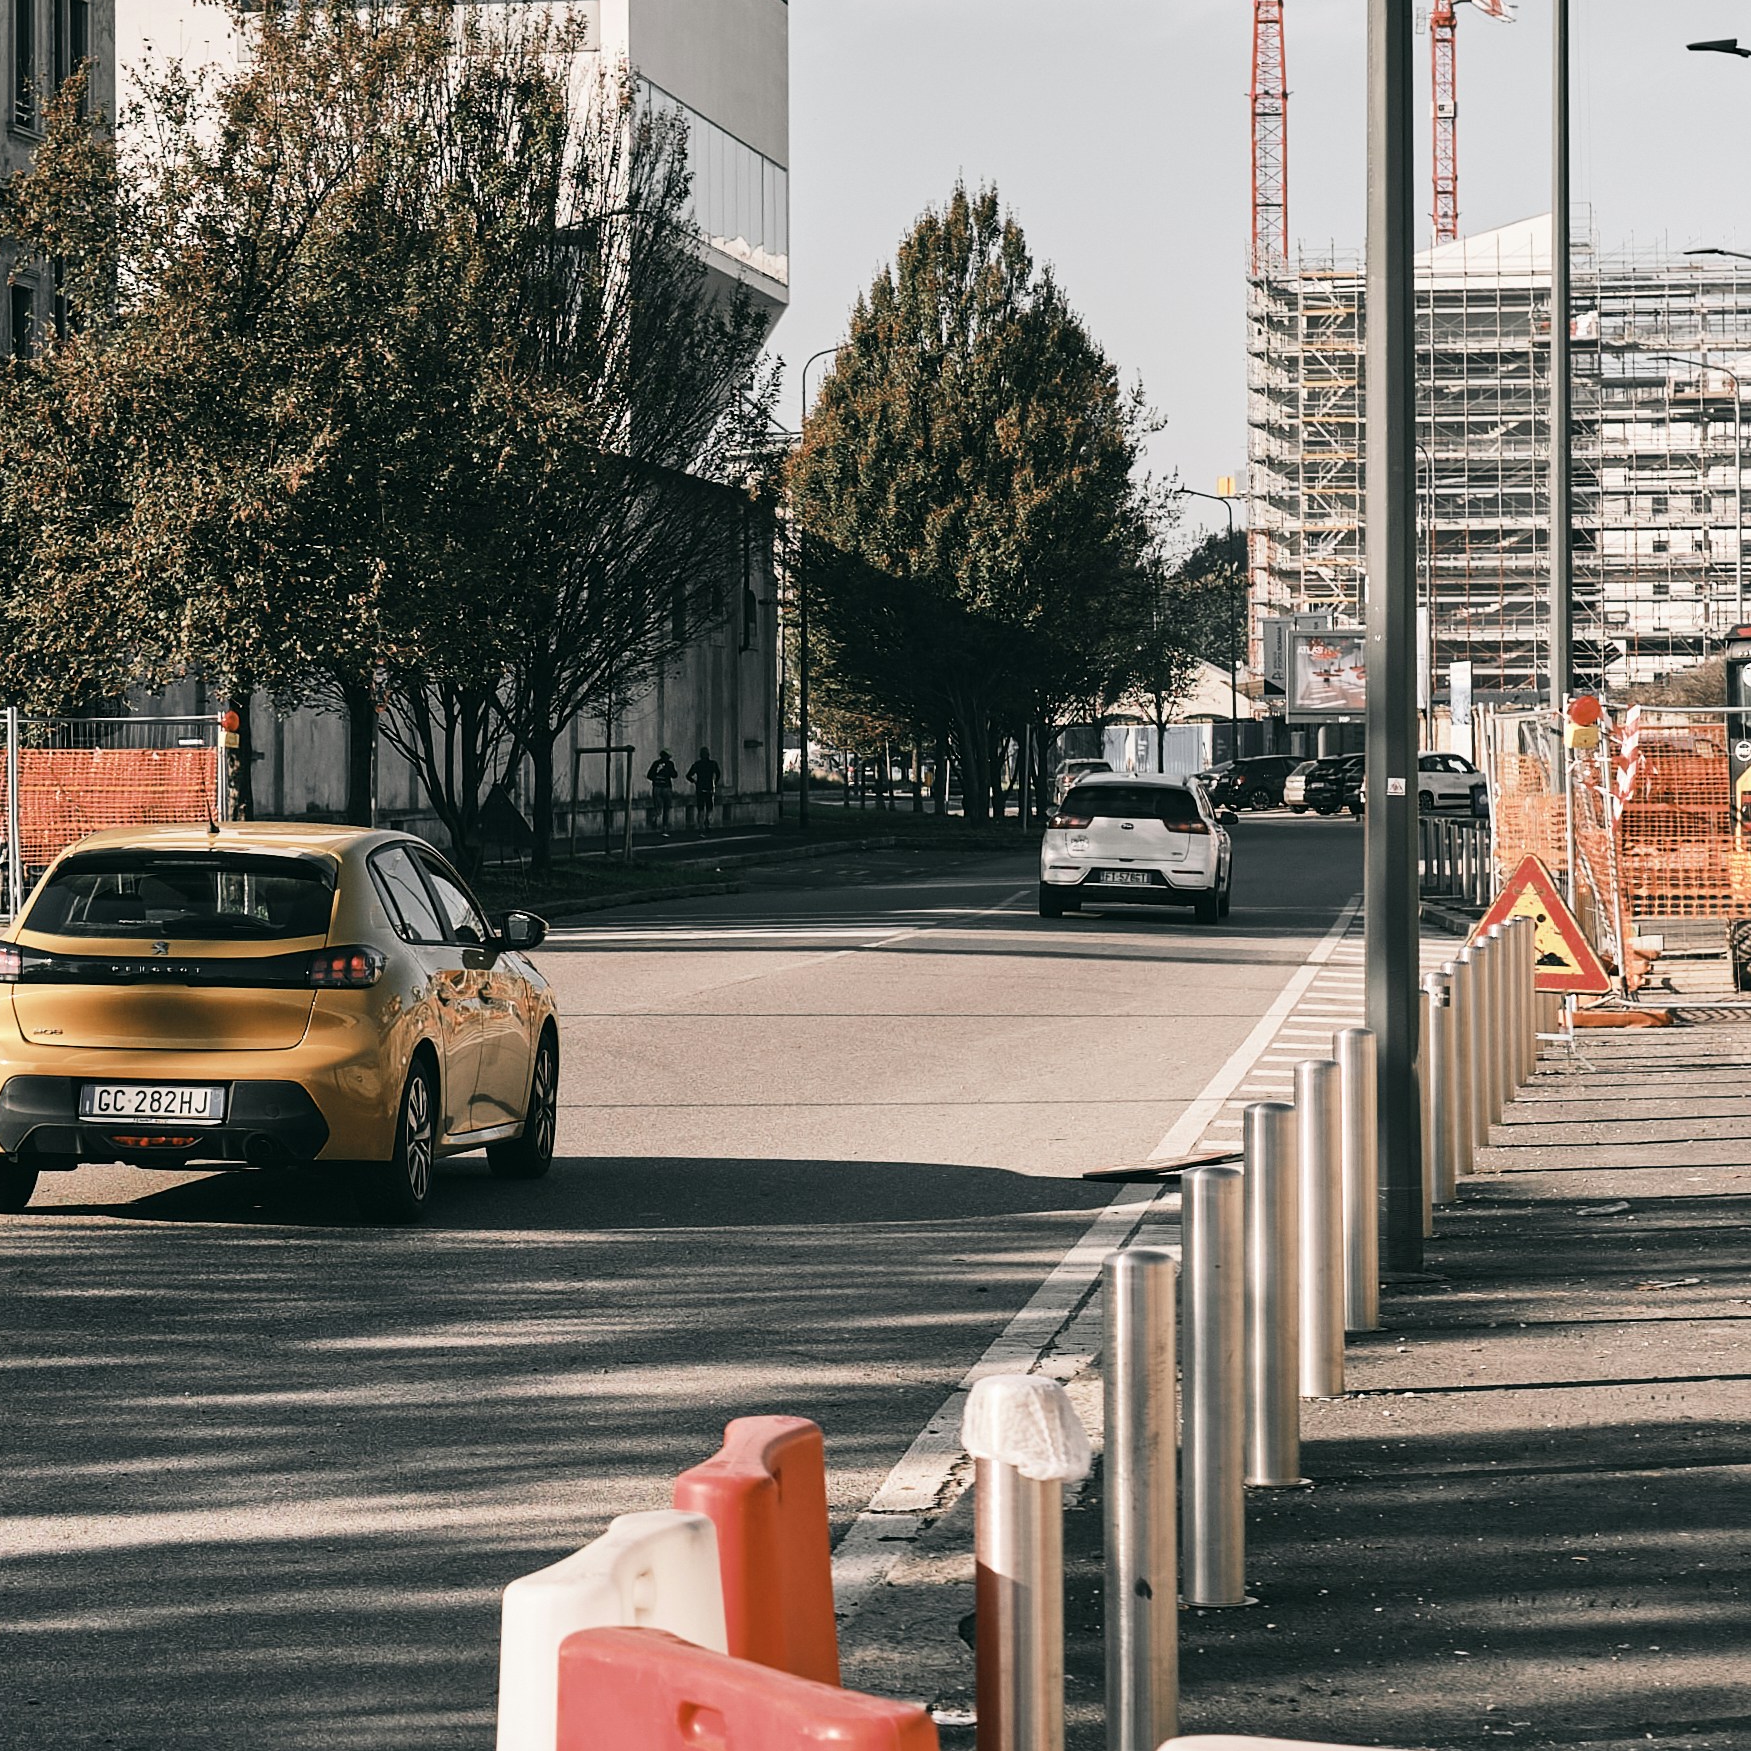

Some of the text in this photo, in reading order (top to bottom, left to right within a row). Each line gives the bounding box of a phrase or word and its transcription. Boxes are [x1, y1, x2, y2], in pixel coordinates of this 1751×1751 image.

[111, 964, 201, 975] PEUGEOT
[97, 1088, 209, 1115] GC 282HJ
